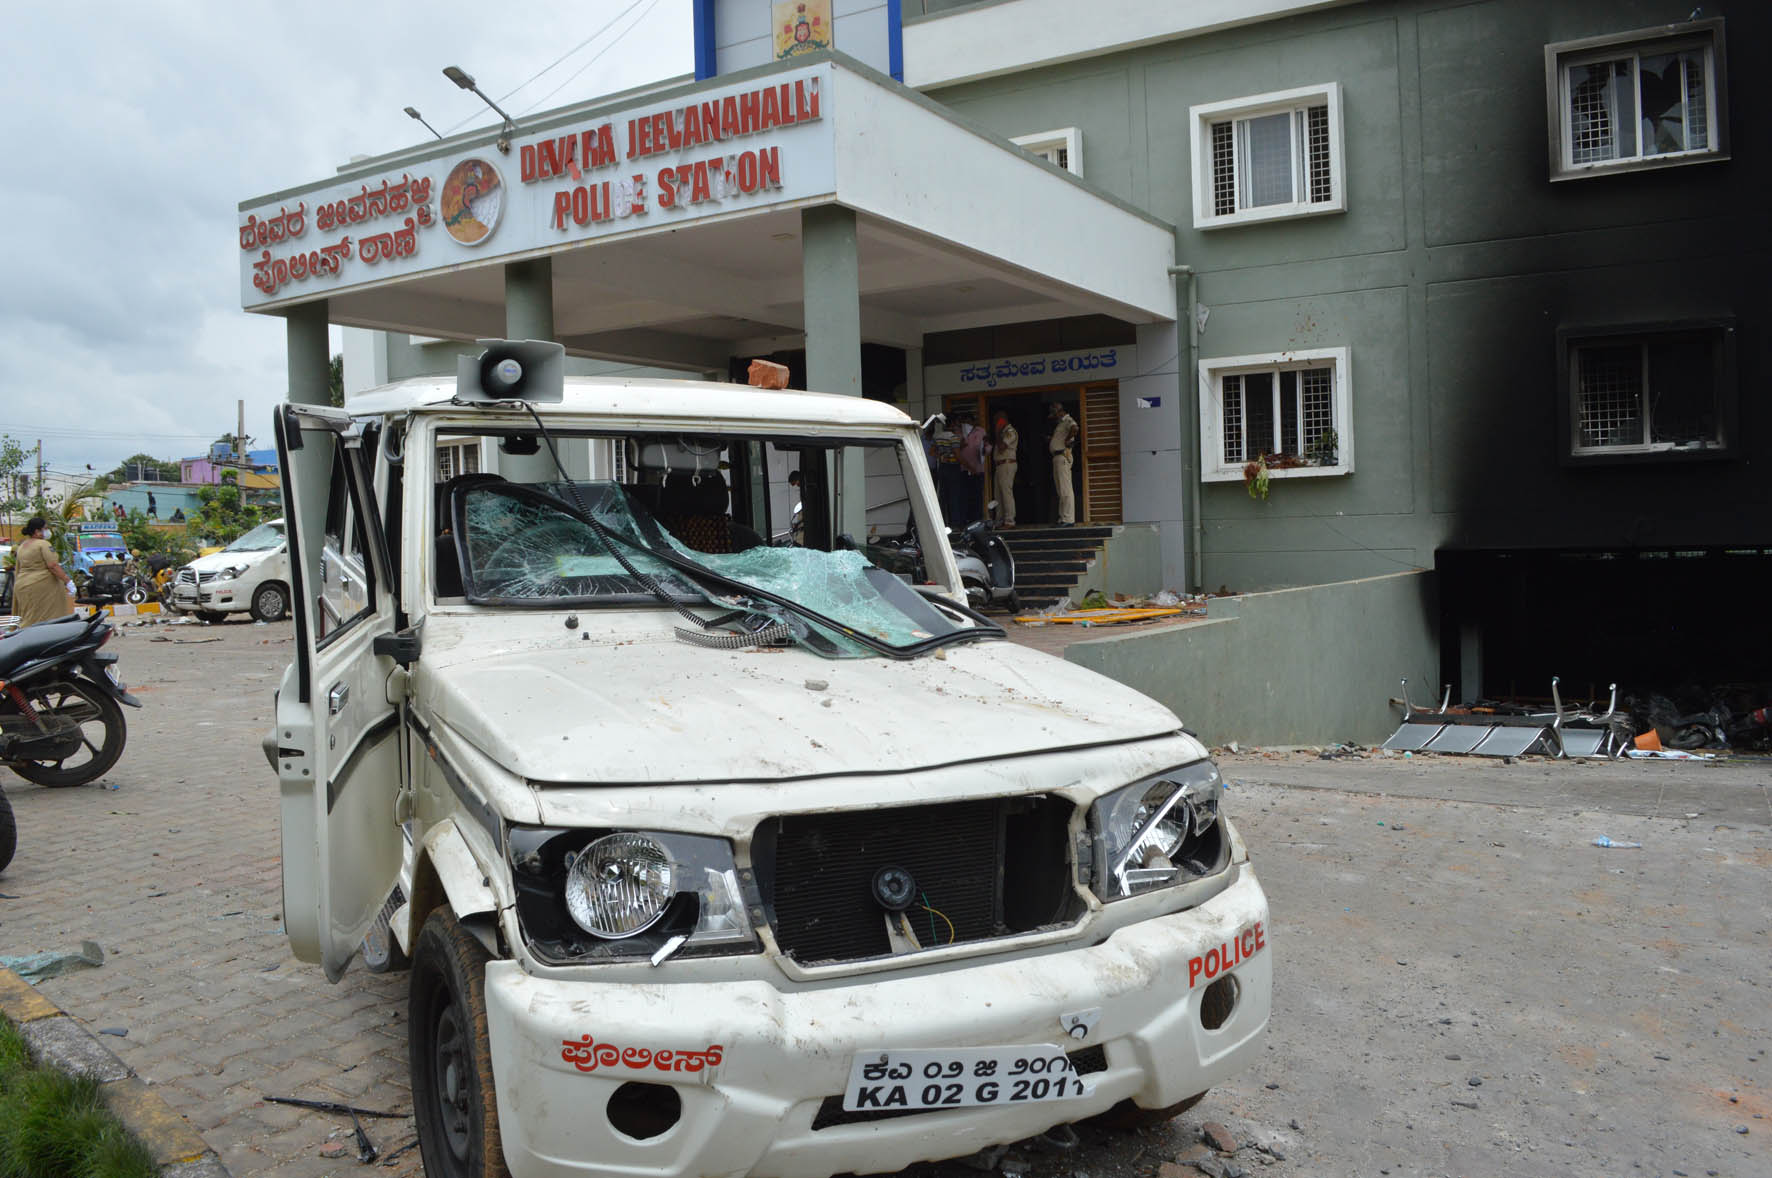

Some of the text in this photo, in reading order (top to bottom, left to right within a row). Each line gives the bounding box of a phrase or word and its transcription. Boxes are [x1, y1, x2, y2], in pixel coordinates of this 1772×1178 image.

[554, 174, 649, 231] POLICE
[239, 202, 307, 250] ದೇವರ
[359, 217, 417, 263] ಠಾಣೆ
[960, 350, 1117, 388] ಸತ್ಯಮೇವ ಜಯತೆ
[1188, 920, 1266, 990] POLICE
[561, 1033, 724, 1073] ಪೊಲೀಸ್
[863, 1054, 913, 1081] ಕೆಎ
[856, 1077, 1085, 1109] KA 02 G 2011
